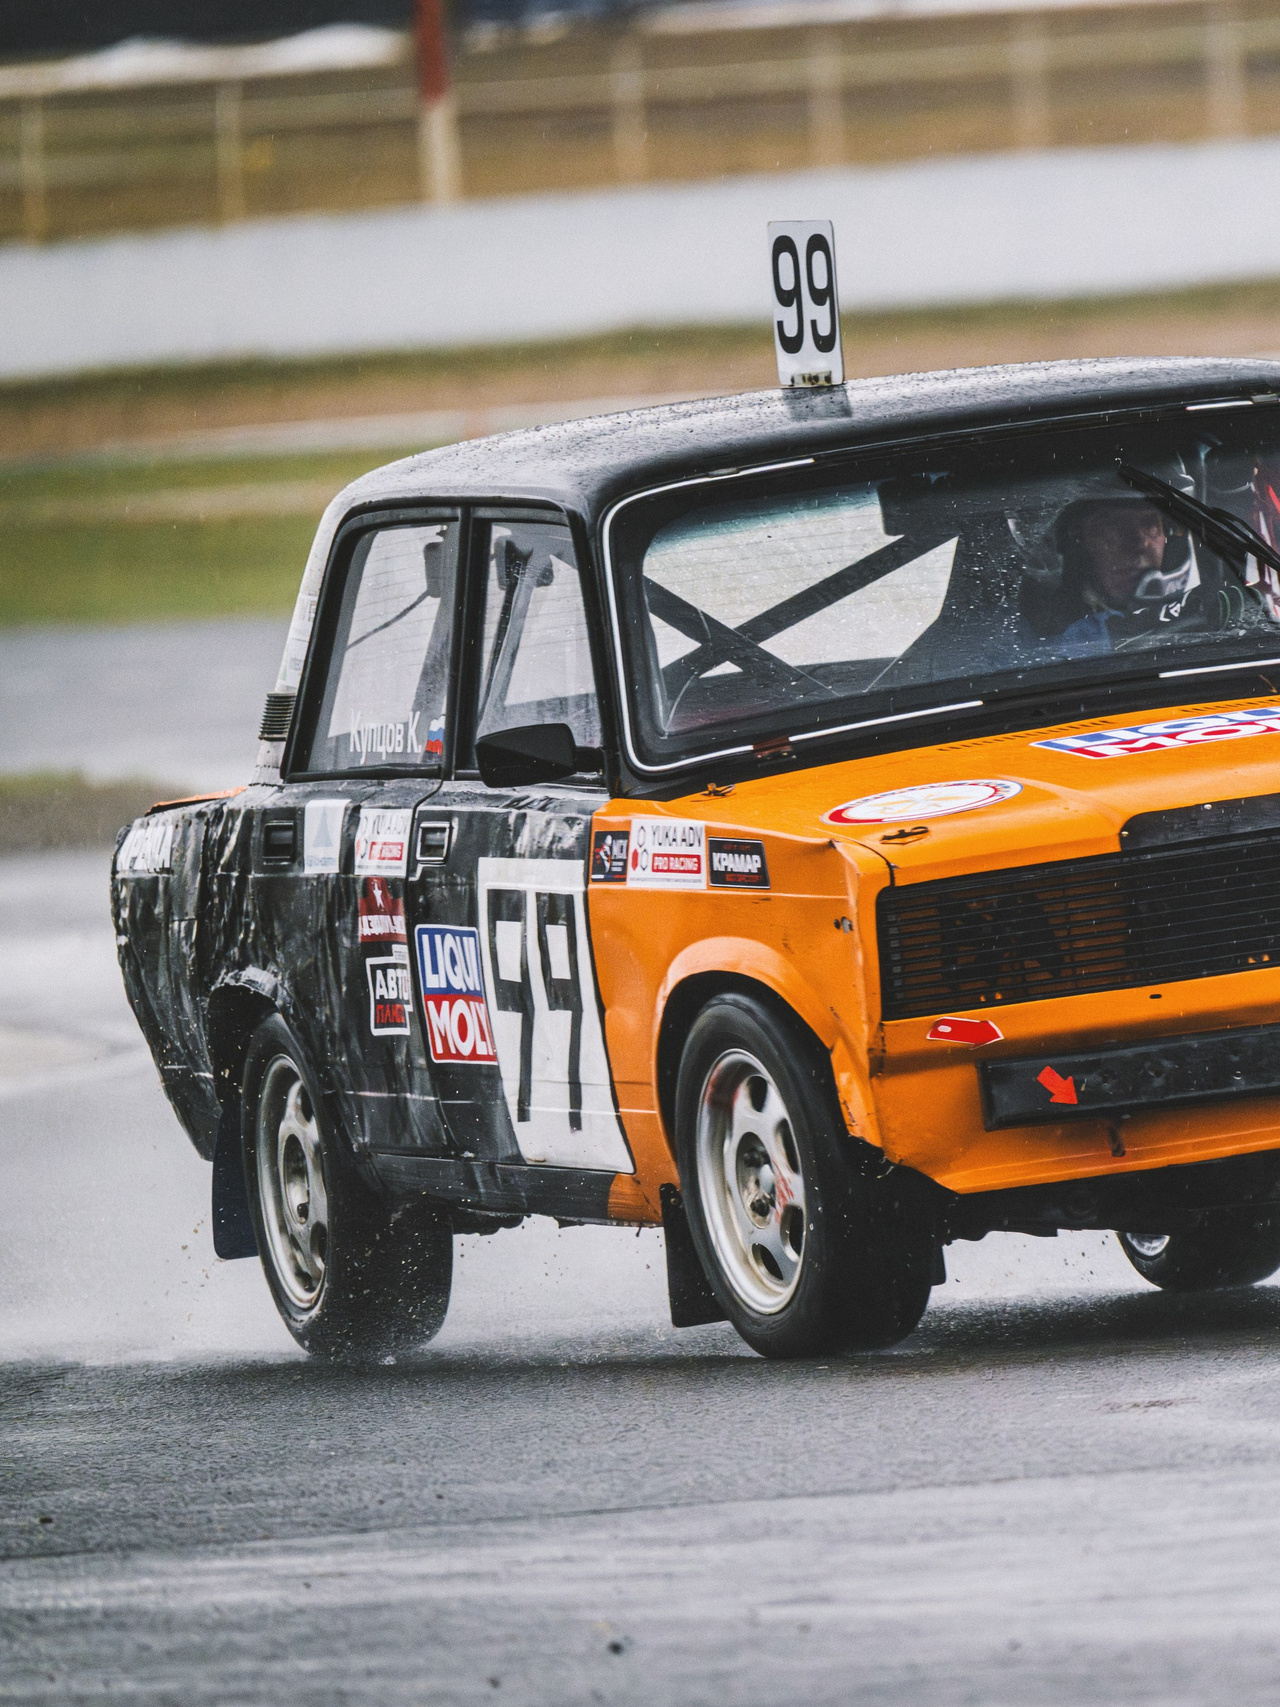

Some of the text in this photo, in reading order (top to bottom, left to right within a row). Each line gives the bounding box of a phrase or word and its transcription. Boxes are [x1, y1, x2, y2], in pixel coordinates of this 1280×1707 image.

[771, 233, 837, 354] 99
[349, 708, 422, 765] Купцов К.
[651, 824, 678, 847] YUKA
[421, 933, 481, 993] LIQUI
[427, 998, 494, 1057] MOLY
[486, 888, 584, 1132] 99
